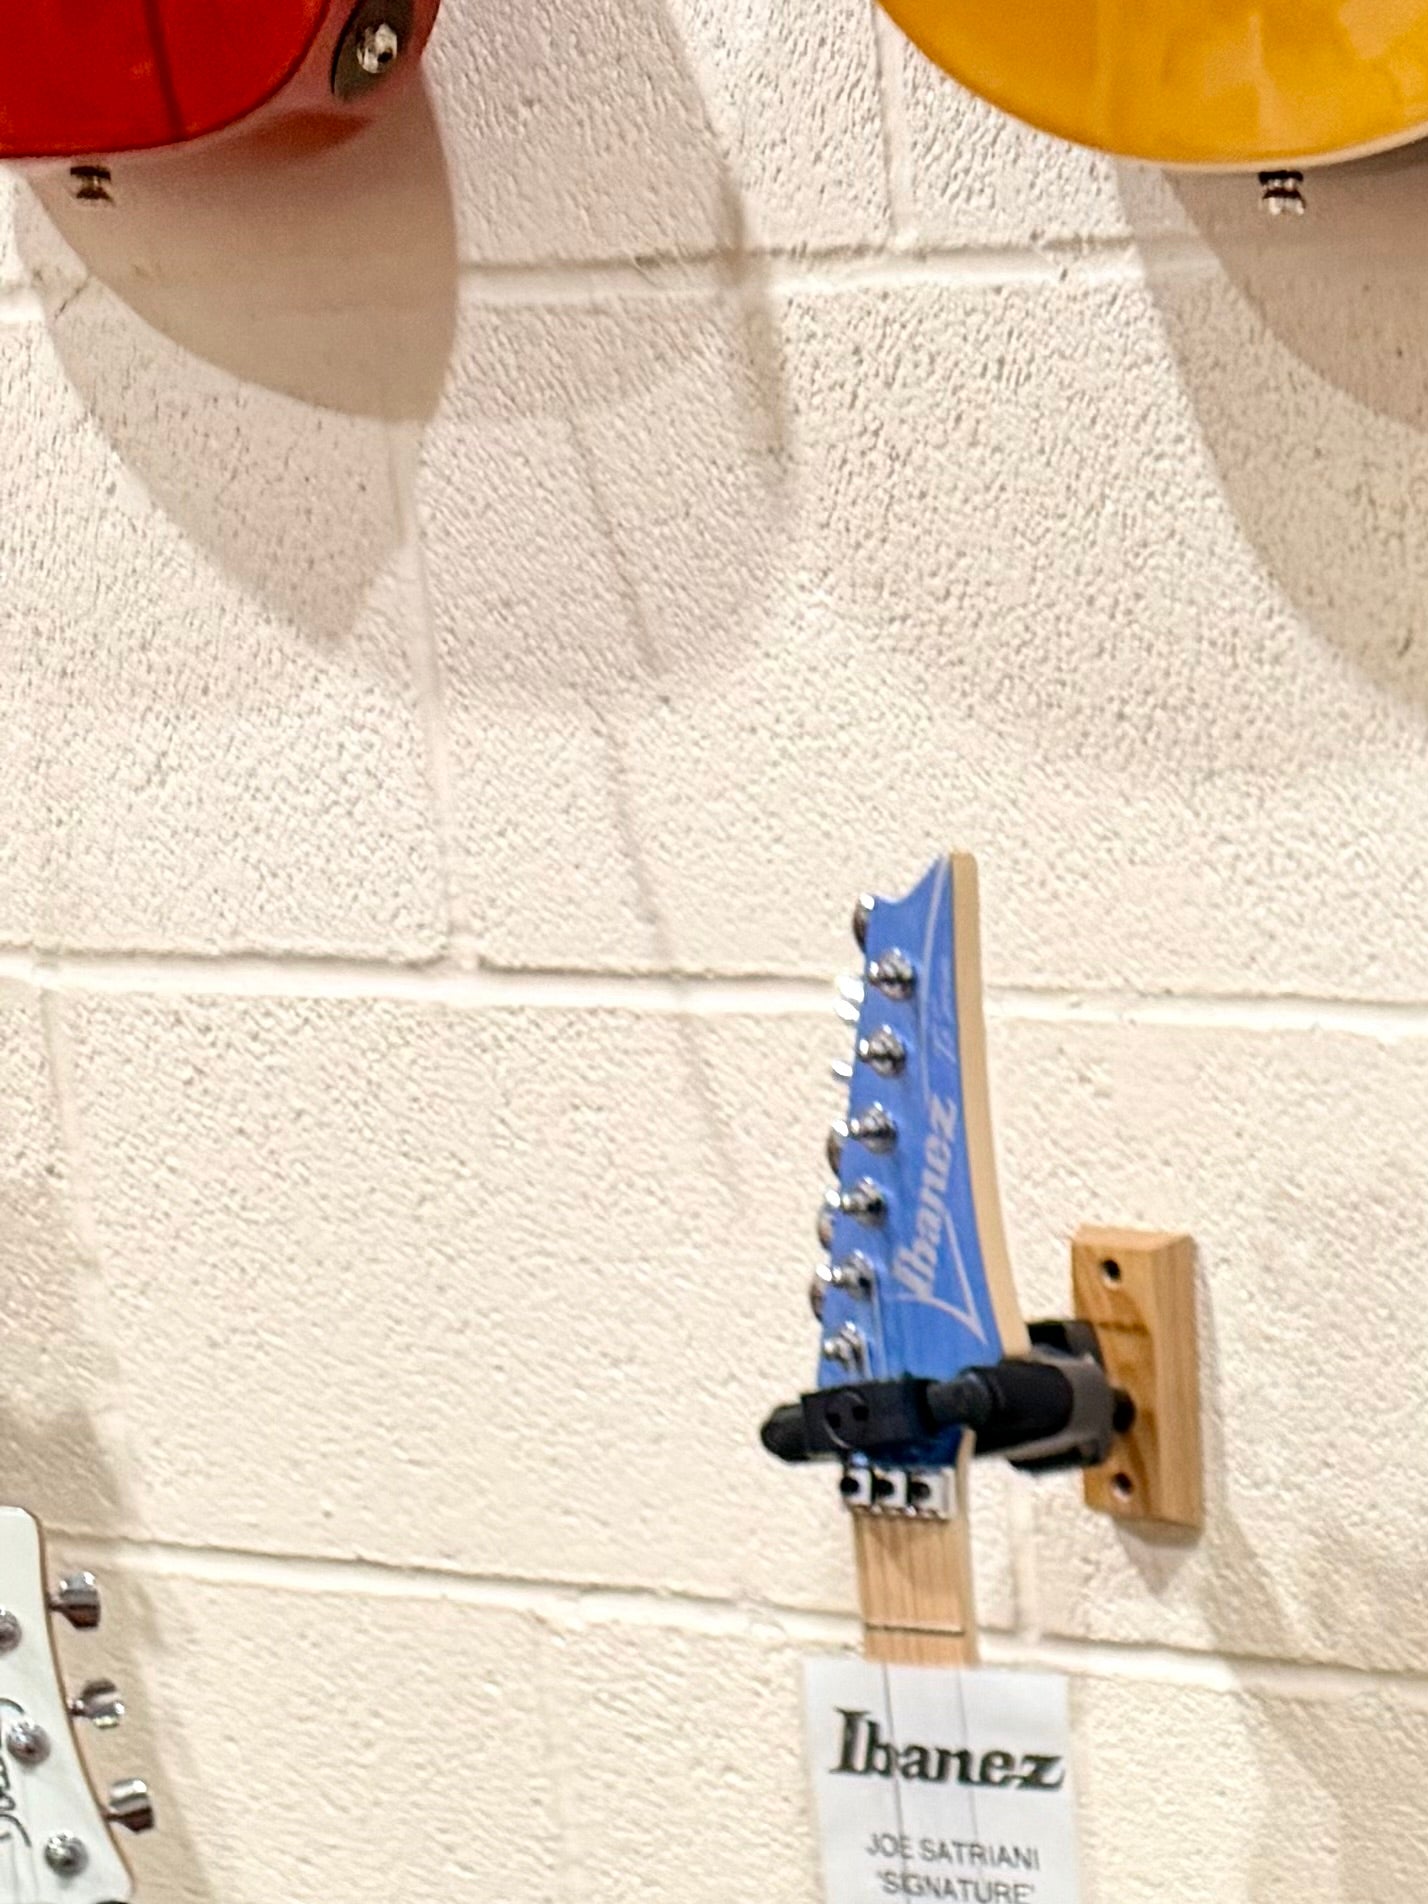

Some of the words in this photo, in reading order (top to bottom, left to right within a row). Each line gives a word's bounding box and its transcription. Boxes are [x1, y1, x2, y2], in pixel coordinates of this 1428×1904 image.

[893, 1094, 959, 1300] Ibanez
[828, 1706, 1066, 1791] Ibanez
[866, 1832, 913, 1861] JOE
[918, 1839, 1040, 1872] SATRIANI
